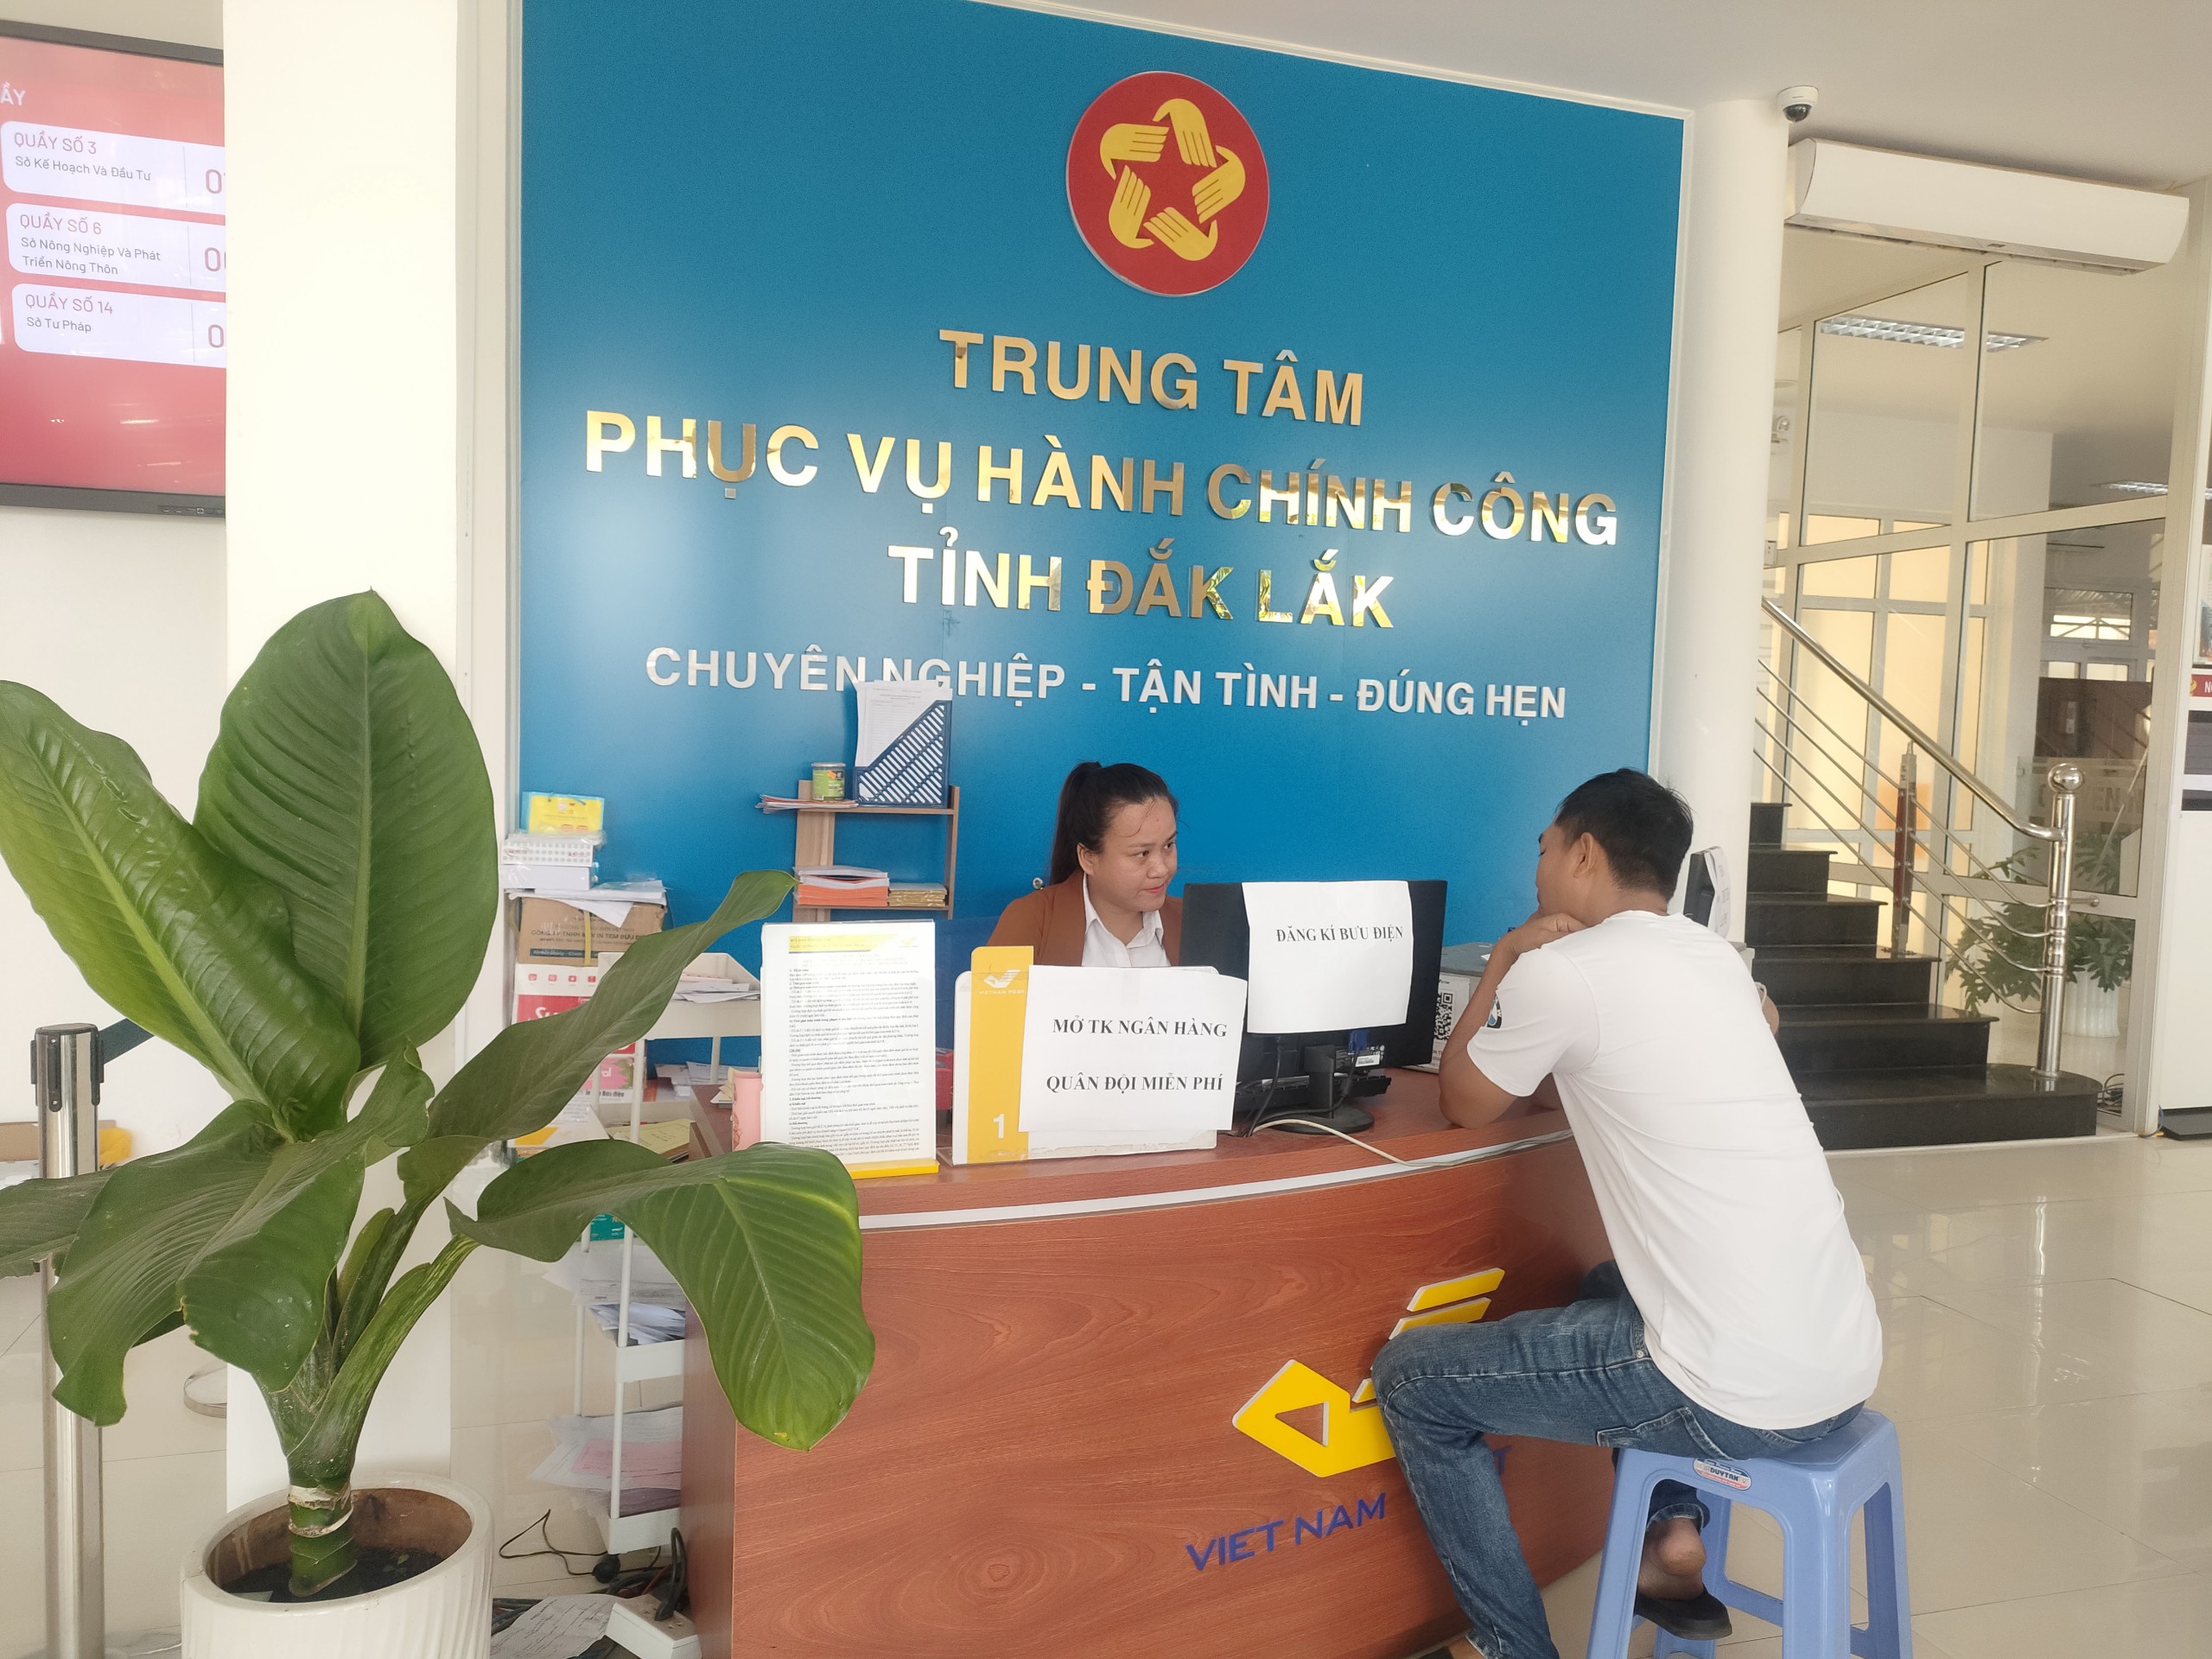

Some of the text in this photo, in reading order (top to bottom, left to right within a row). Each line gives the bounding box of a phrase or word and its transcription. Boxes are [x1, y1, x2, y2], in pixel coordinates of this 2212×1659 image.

[14, 130, 97, 154] QUẦY SỐ 3
[16, 156, 31, 167] Sở
[53, 160, 90, 174] Hoạch
[92, 164, 107, 176] Và
[111, 167, 133, 179] Đầu
[136, 169, 151, 181] Tư
[205, 168, 226, 194] 0
[20, 212, 102, 235] QUẦY SỐ 6
[21, 237, 161, 261] Sở Nông Nghiệp Và Phát
[204, 247, 226, 272] 0
[22, 256, 118, 275] Triển Nông Thôn
[25, 292, 113, 314] QUẦY SỐ 14
[27, 317, 92, 334] Sở Tư Pháp
[939, 329, 1363, 426] TRUNG TÂM
[586, 410, 1618, 546] PHỤC VỤ HÀNH CHÍNH CÔNG
[887, 526, 1395, 628] TỈNH ĐẮK LẮK
[645, 643, 1566, 726] CHUYÊN NGHIỆP - TẬN TÌNH - ĐÚNG HẸN
[1275, 924, 1403, 942] ĐĂNG KÍ BƯU ĐIỆN
[1052, 1015, 1227, 1037] MỞ TK NGÂN HÀNG
[1046, 1071, 1224, 1094] QUÂN ĐỘI MIỄN PHÍ
[993, 1113, 1005, 1139] 1
[1185, 1492, 1386, 1571] VIET NAM
